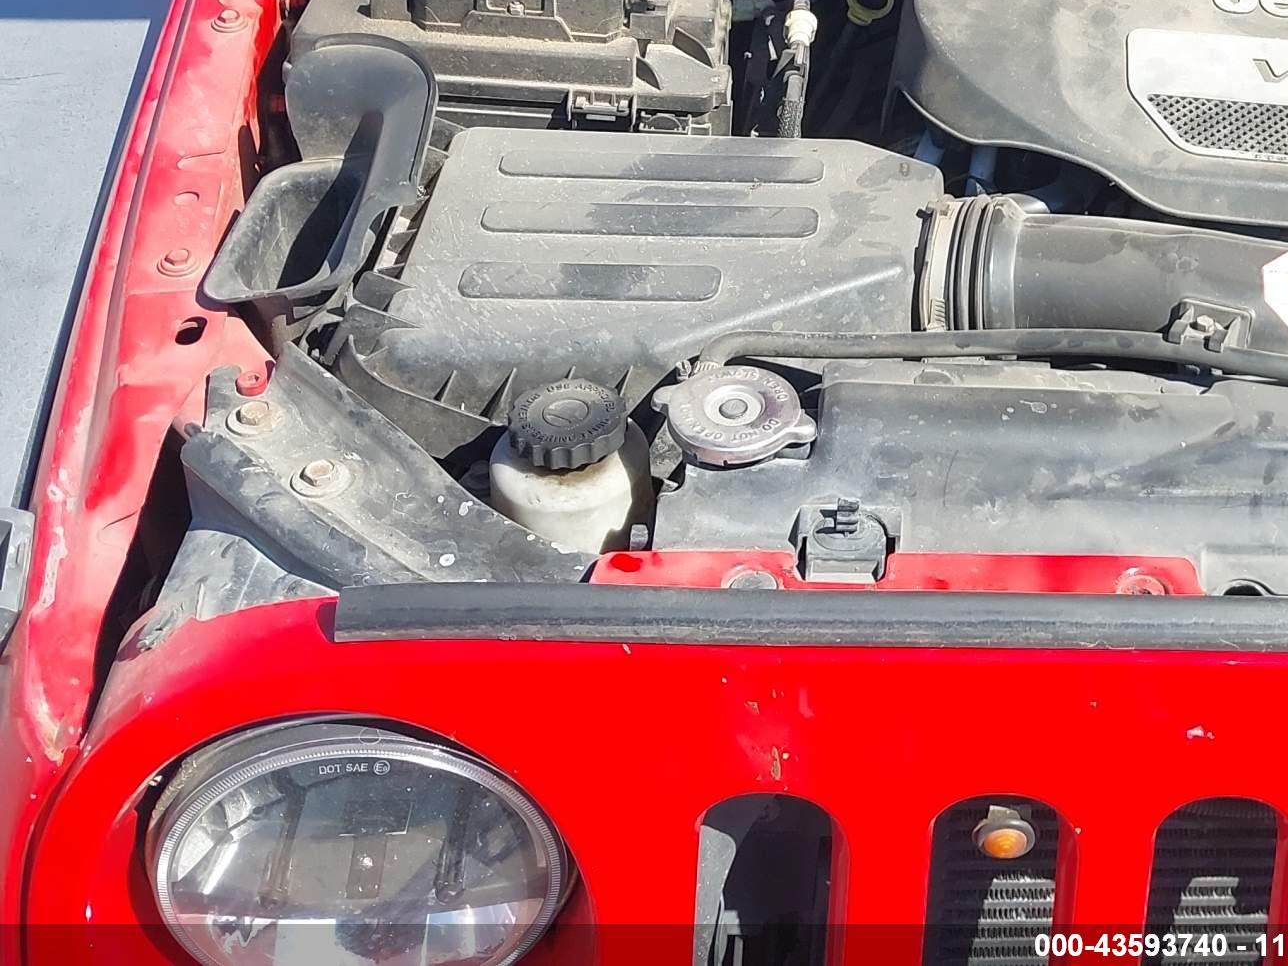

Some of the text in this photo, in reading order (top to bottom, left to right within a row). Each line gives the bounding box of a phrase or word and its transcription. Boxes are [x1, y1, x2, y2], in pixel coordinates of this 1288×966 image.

[761, 417, 781, 432] DO
[318, 764, 341, 774] DOT
[345, 762, 369, 772] SAE
